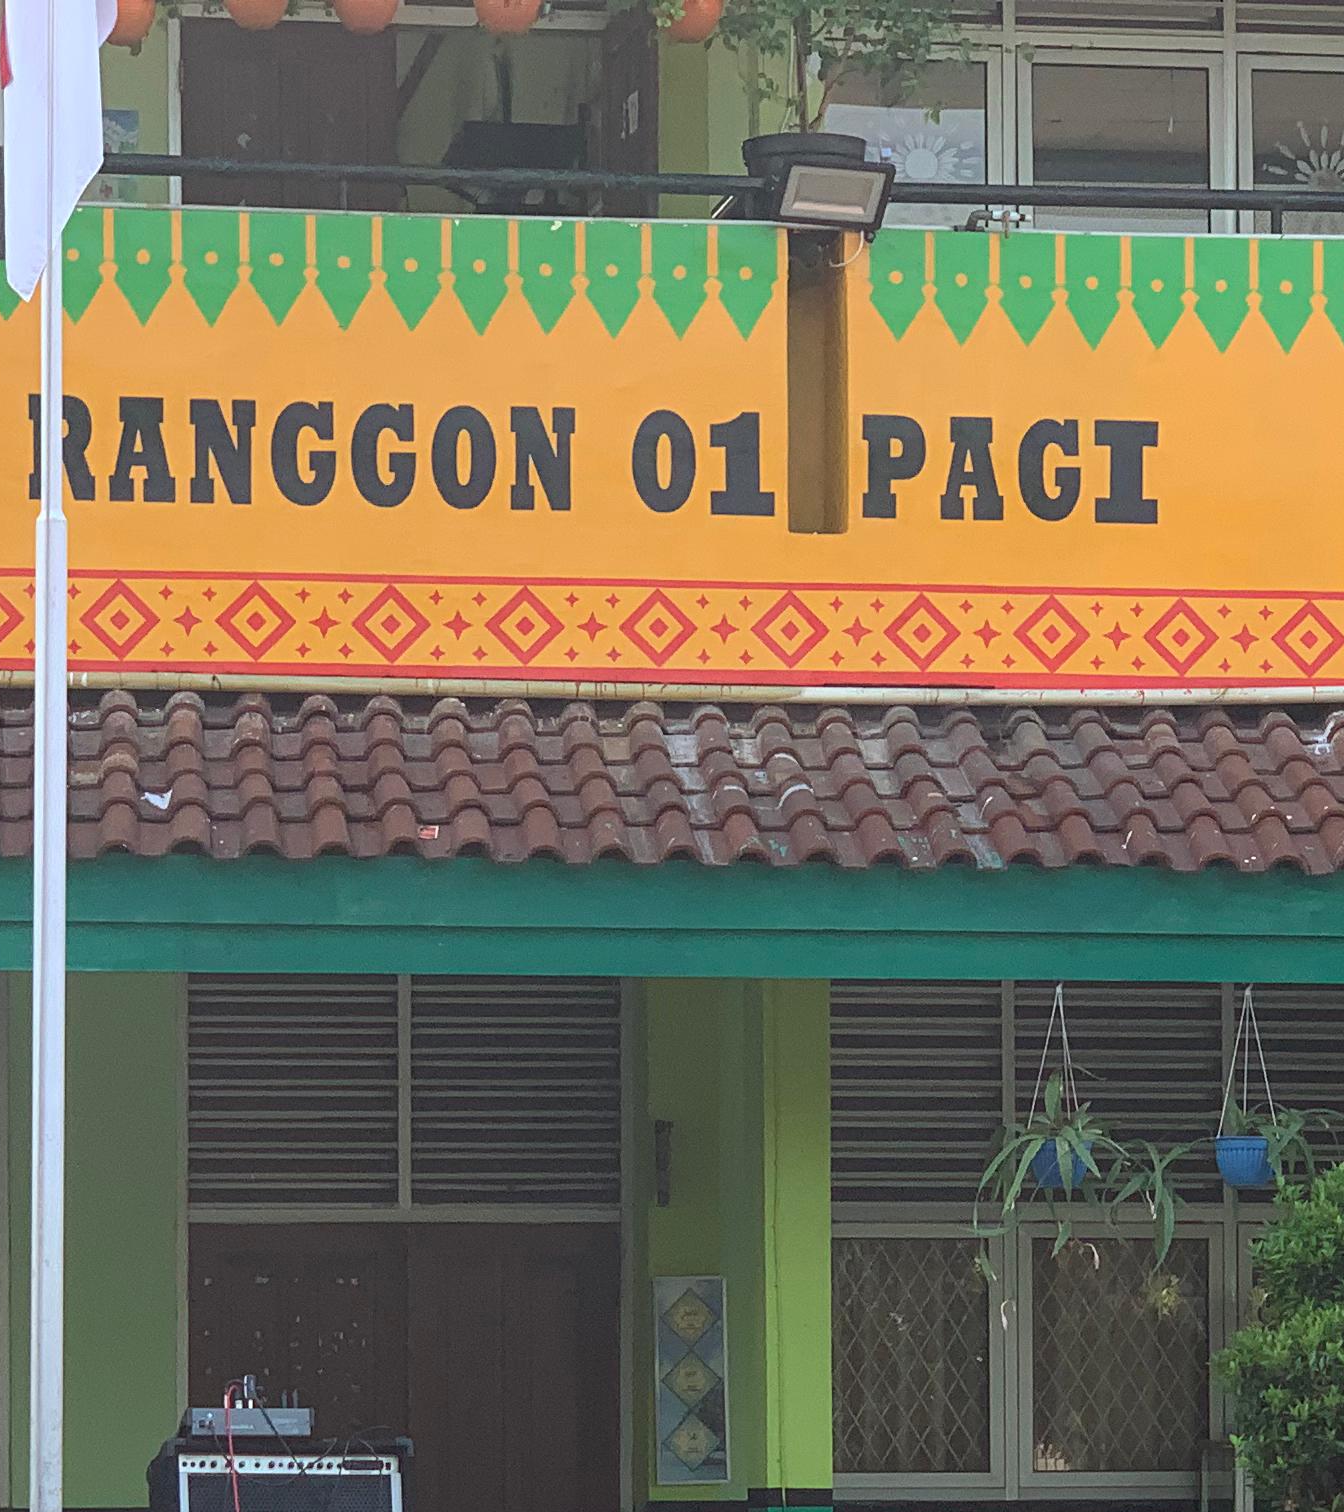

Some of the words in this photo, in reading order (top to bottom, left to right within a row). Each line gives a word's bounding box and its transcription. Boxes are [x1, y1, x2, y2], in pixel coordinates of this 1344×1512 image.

[27, 393, 576, 511] RANGGON
[632, 409, 776, 516] 01
[861, 414, 1160, 524] PAGI
